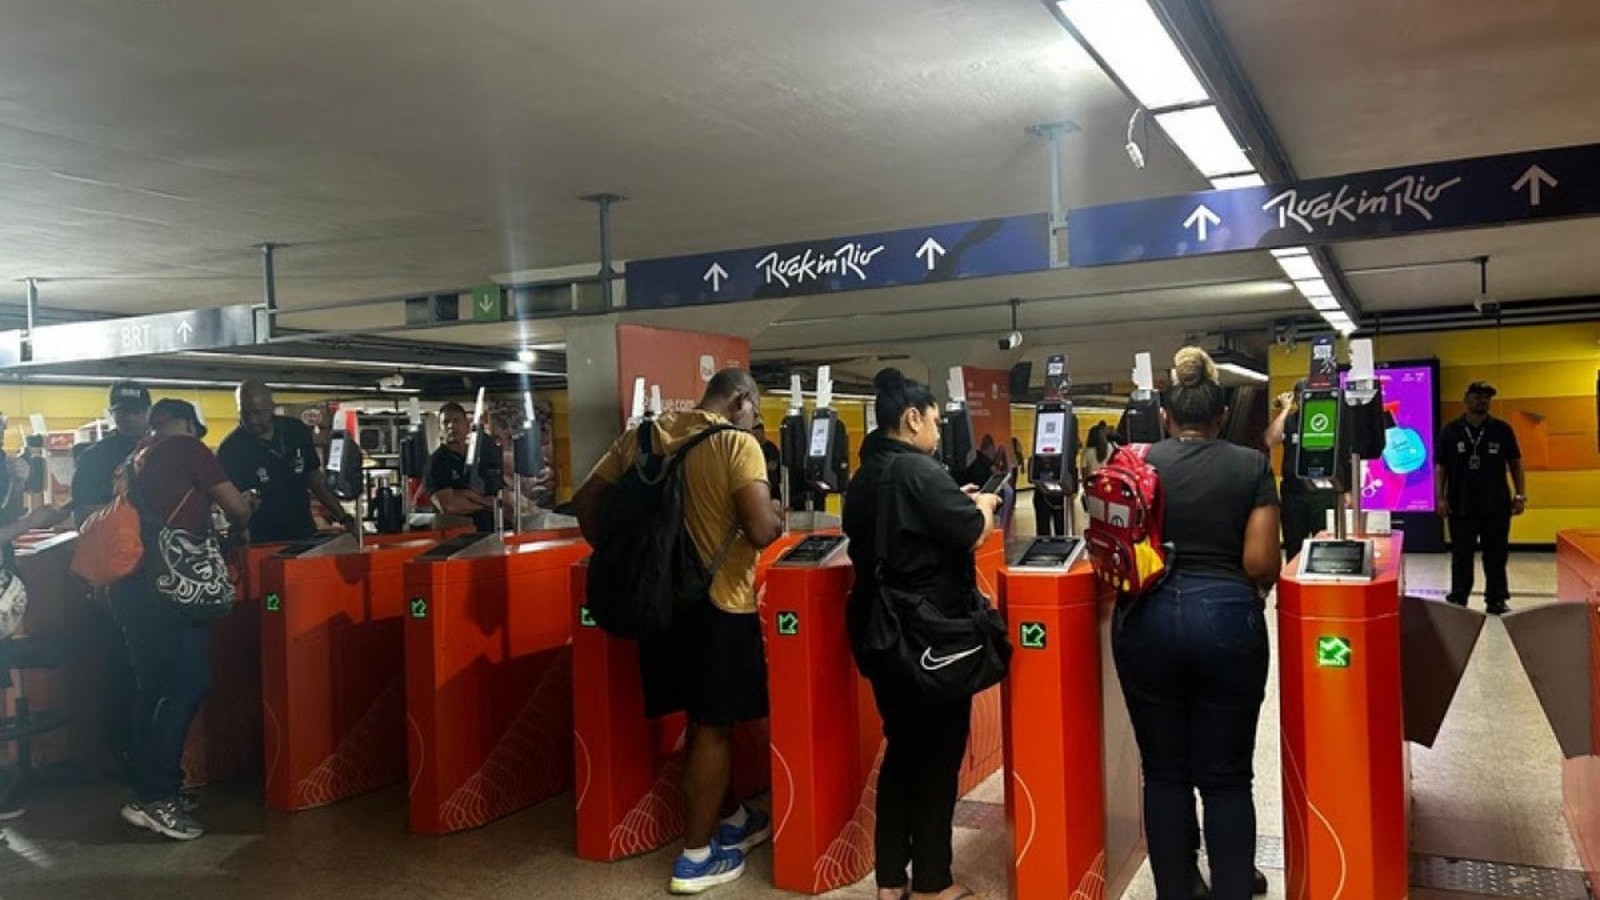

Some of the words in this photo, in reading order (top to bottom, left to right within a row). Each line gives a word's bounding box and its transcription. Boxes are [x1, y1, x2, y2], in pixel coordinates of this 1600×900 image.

[1262, 184, 1356, 233] Rock
[1356, 190, 1388, 214] in
[1385, 175, 1461, 221] Rio
[755, 249, 816, 288] Rock
[817, 253, 837, 274] in
[834, 243, 884, 280] Rio
[121, 325, 150, 348] BRT
